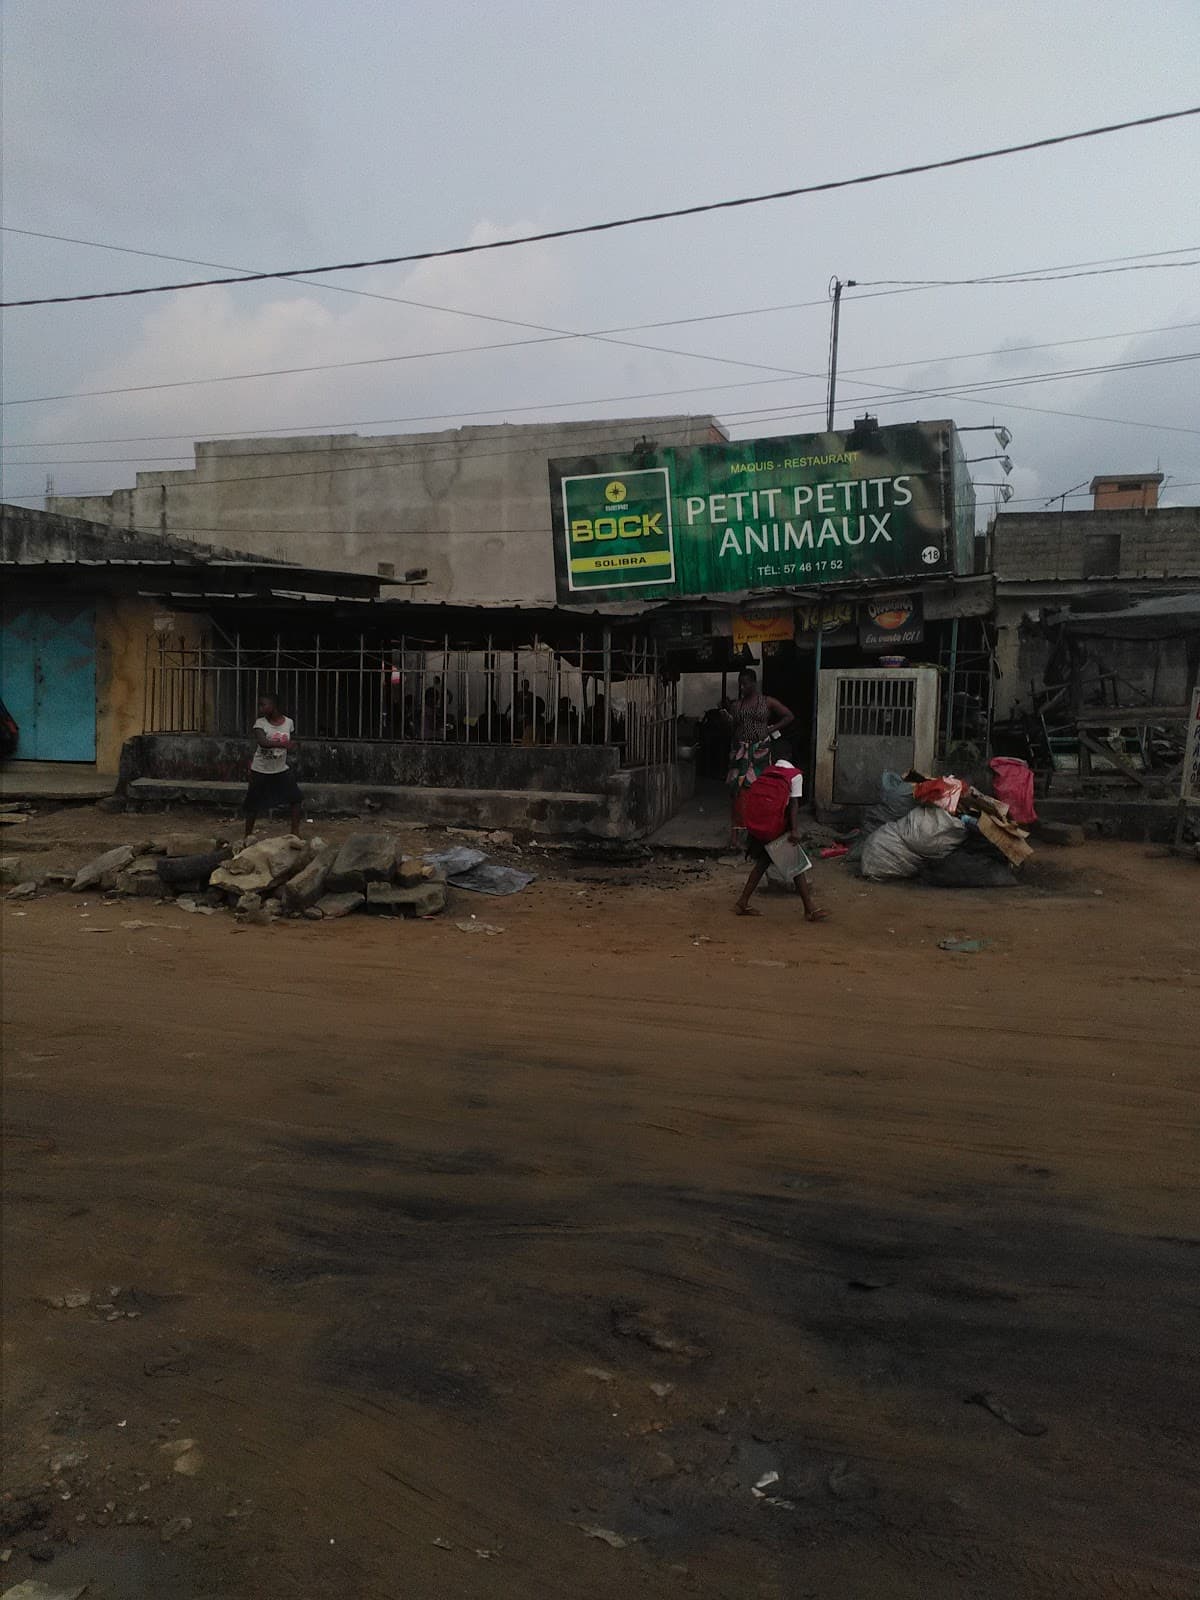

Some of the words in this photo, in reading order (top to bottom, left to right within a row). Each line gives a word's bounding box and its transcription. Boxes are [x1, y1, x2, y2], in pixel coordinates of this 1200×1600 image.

[730, 459, 774, 474] MAQUIS
[784, 452, 859, 469] RESTAURANT
[686, 487, 782, 526] PETIT
[794, 475, 913, 515] PETITS
[571, 512, 664, 543] BOCK
[718, 513, 893, 557] ANIMAUX
[594, 556, 647, 568] SOLIBRA
[921, 549, 940, 562] +18
[757, 563, 781, 577] TÉL:
[783, 562, 797, 575] 57
[815, 560, 829, 572] 17
[830, 559, 844, 571] 52
